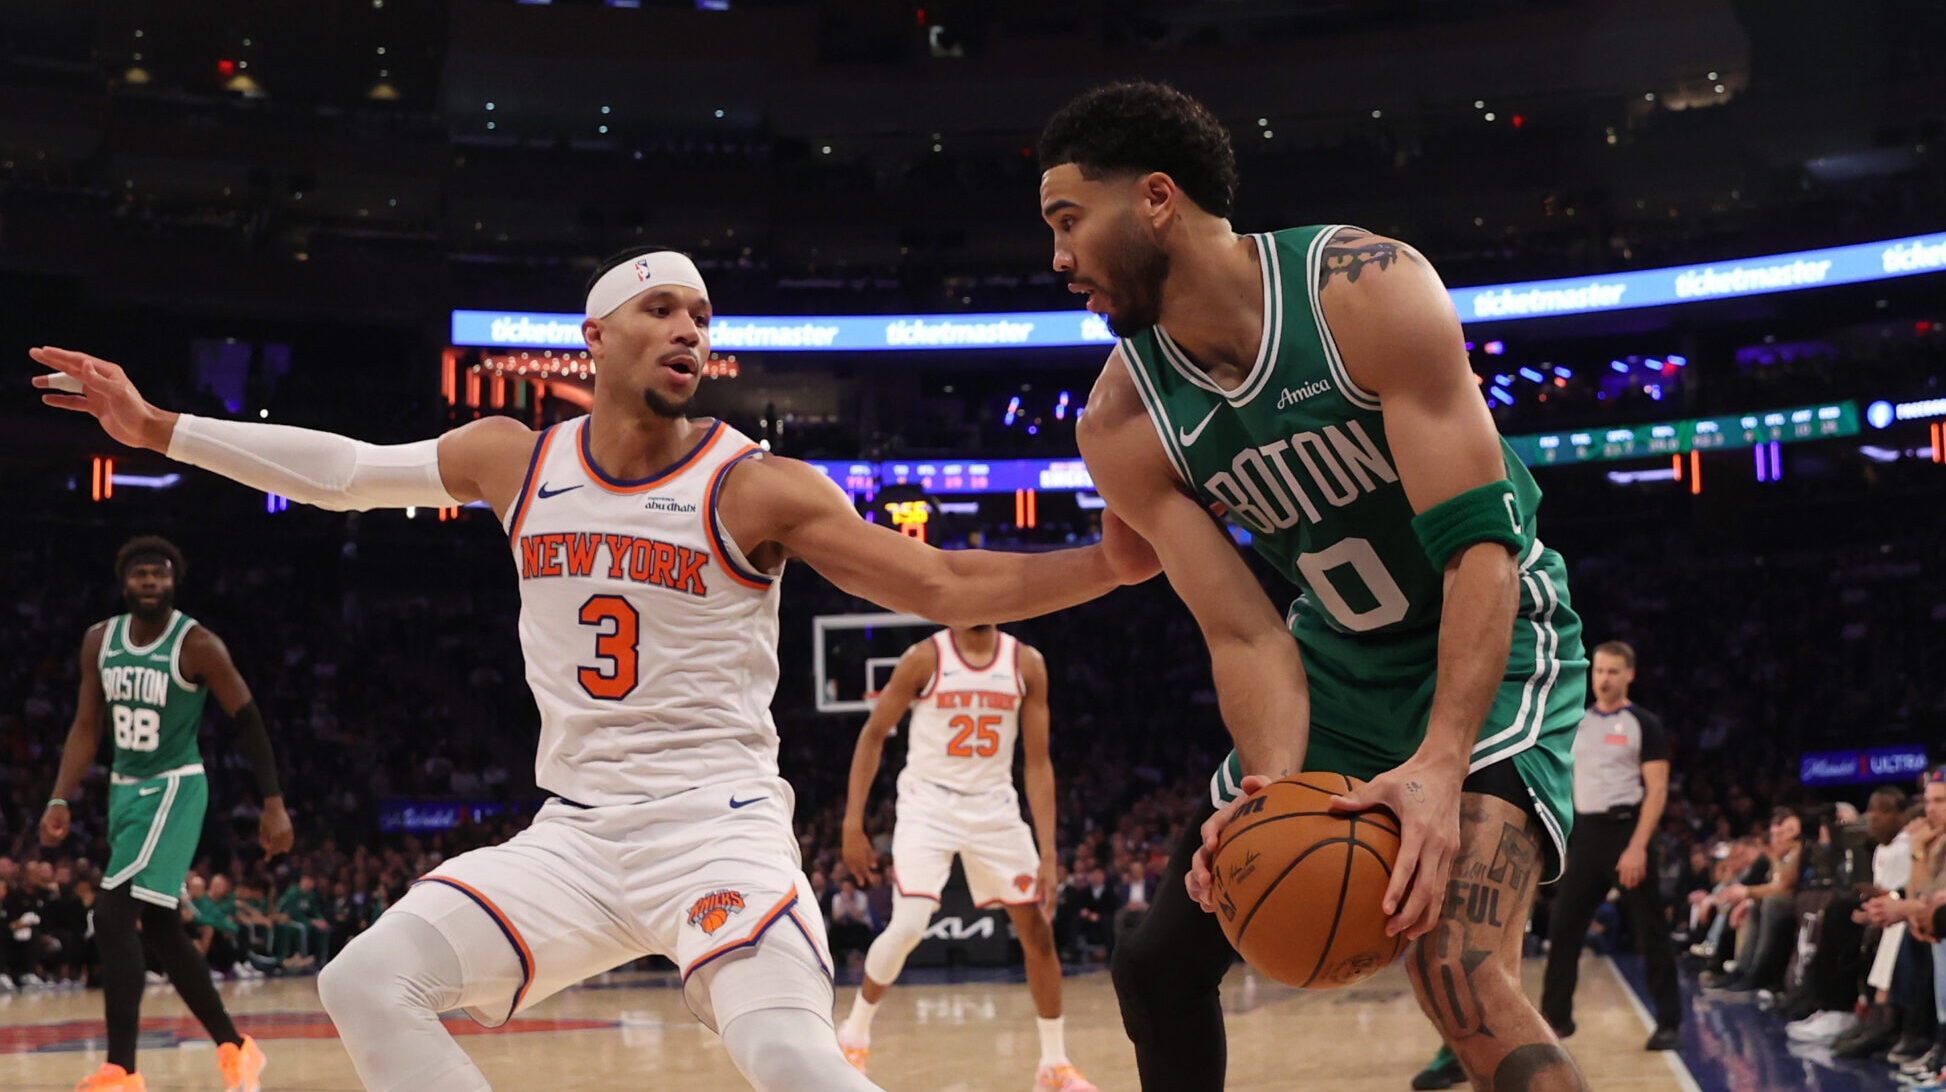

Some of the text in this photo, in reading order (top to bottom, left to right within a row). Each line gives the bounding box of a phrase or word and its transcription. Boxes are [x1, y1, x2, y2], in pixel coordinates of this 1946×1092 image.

[1675, 260, 1831, 298] ticketmaster
[1474, 284, 1626, 317] ticketmaster
[490, 316, 586, 344] ticketm
[708, 321, 839, 346] cketmaster
[886, 319, 1034, 346] ticketmaster
[1277, 379, 1331, 410] Amica
[645, 501, 697, 513] abu dhabi
[521, 532, 710, 598] NEW YORK
[1296, 537, 1411, 632] 0
[577, 593, 640, 701] 3
[101, 665, 170, 708] BOSTON
[936, 690, 974, 709] NEW
[112, 704, 161, 752] 88
[946, 714, 1002, 757] 25
[1870, 753, 1928, 775] ULTRA
[687, 890, 746, 927] KNICKS
